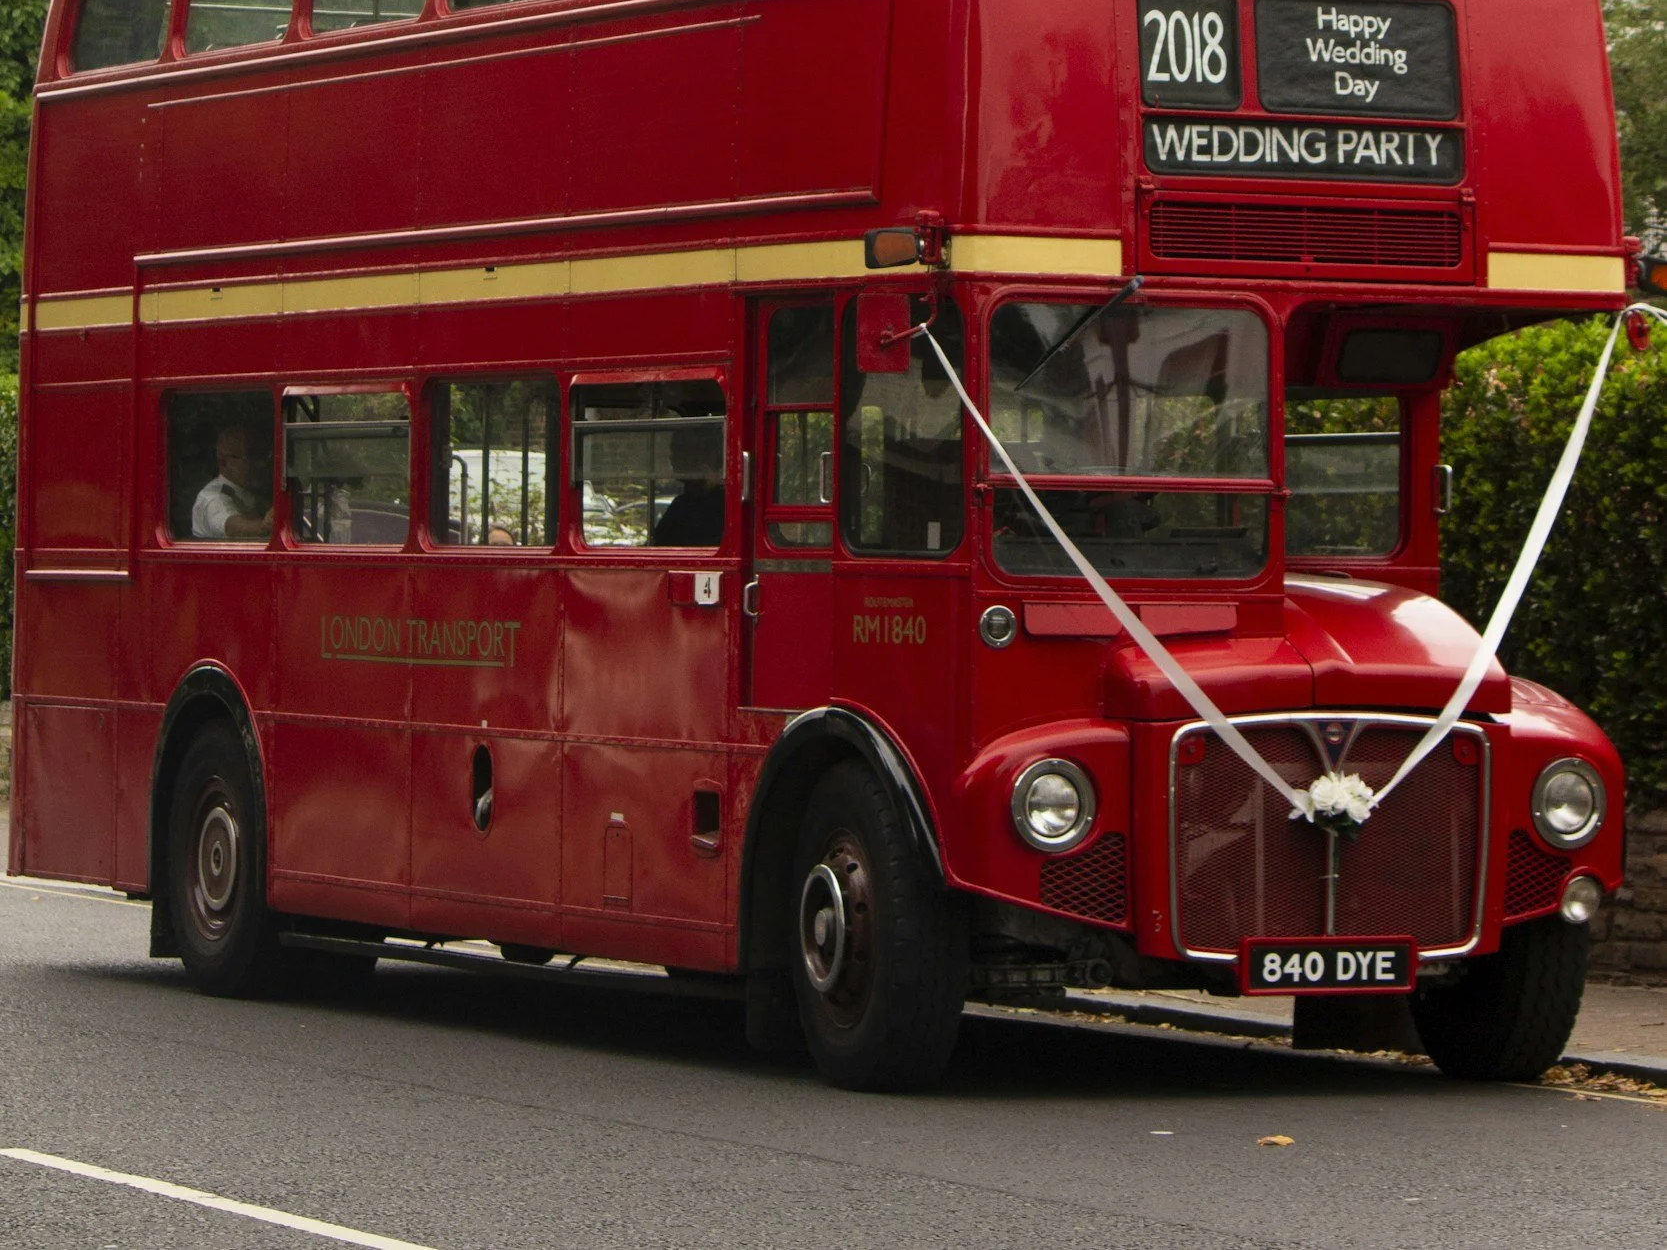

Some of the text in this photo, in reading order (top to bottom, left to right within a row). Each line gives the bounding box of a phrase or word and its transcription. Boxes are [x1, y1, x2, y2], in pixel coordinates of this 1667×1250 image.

[1317, 6, 1392, 40] Happy
[1144, 9, 1228, 84] 2018
[1306, 37, 1408, 75] Wedding
[1334, 71, 1380, 103] Day
[1152, 124, 1443, 166] WEDDING PARTY
[321, 614, 521, 668] LONDON TRANSPORT
[1262, 951, 1396, 983] 840 DYE
